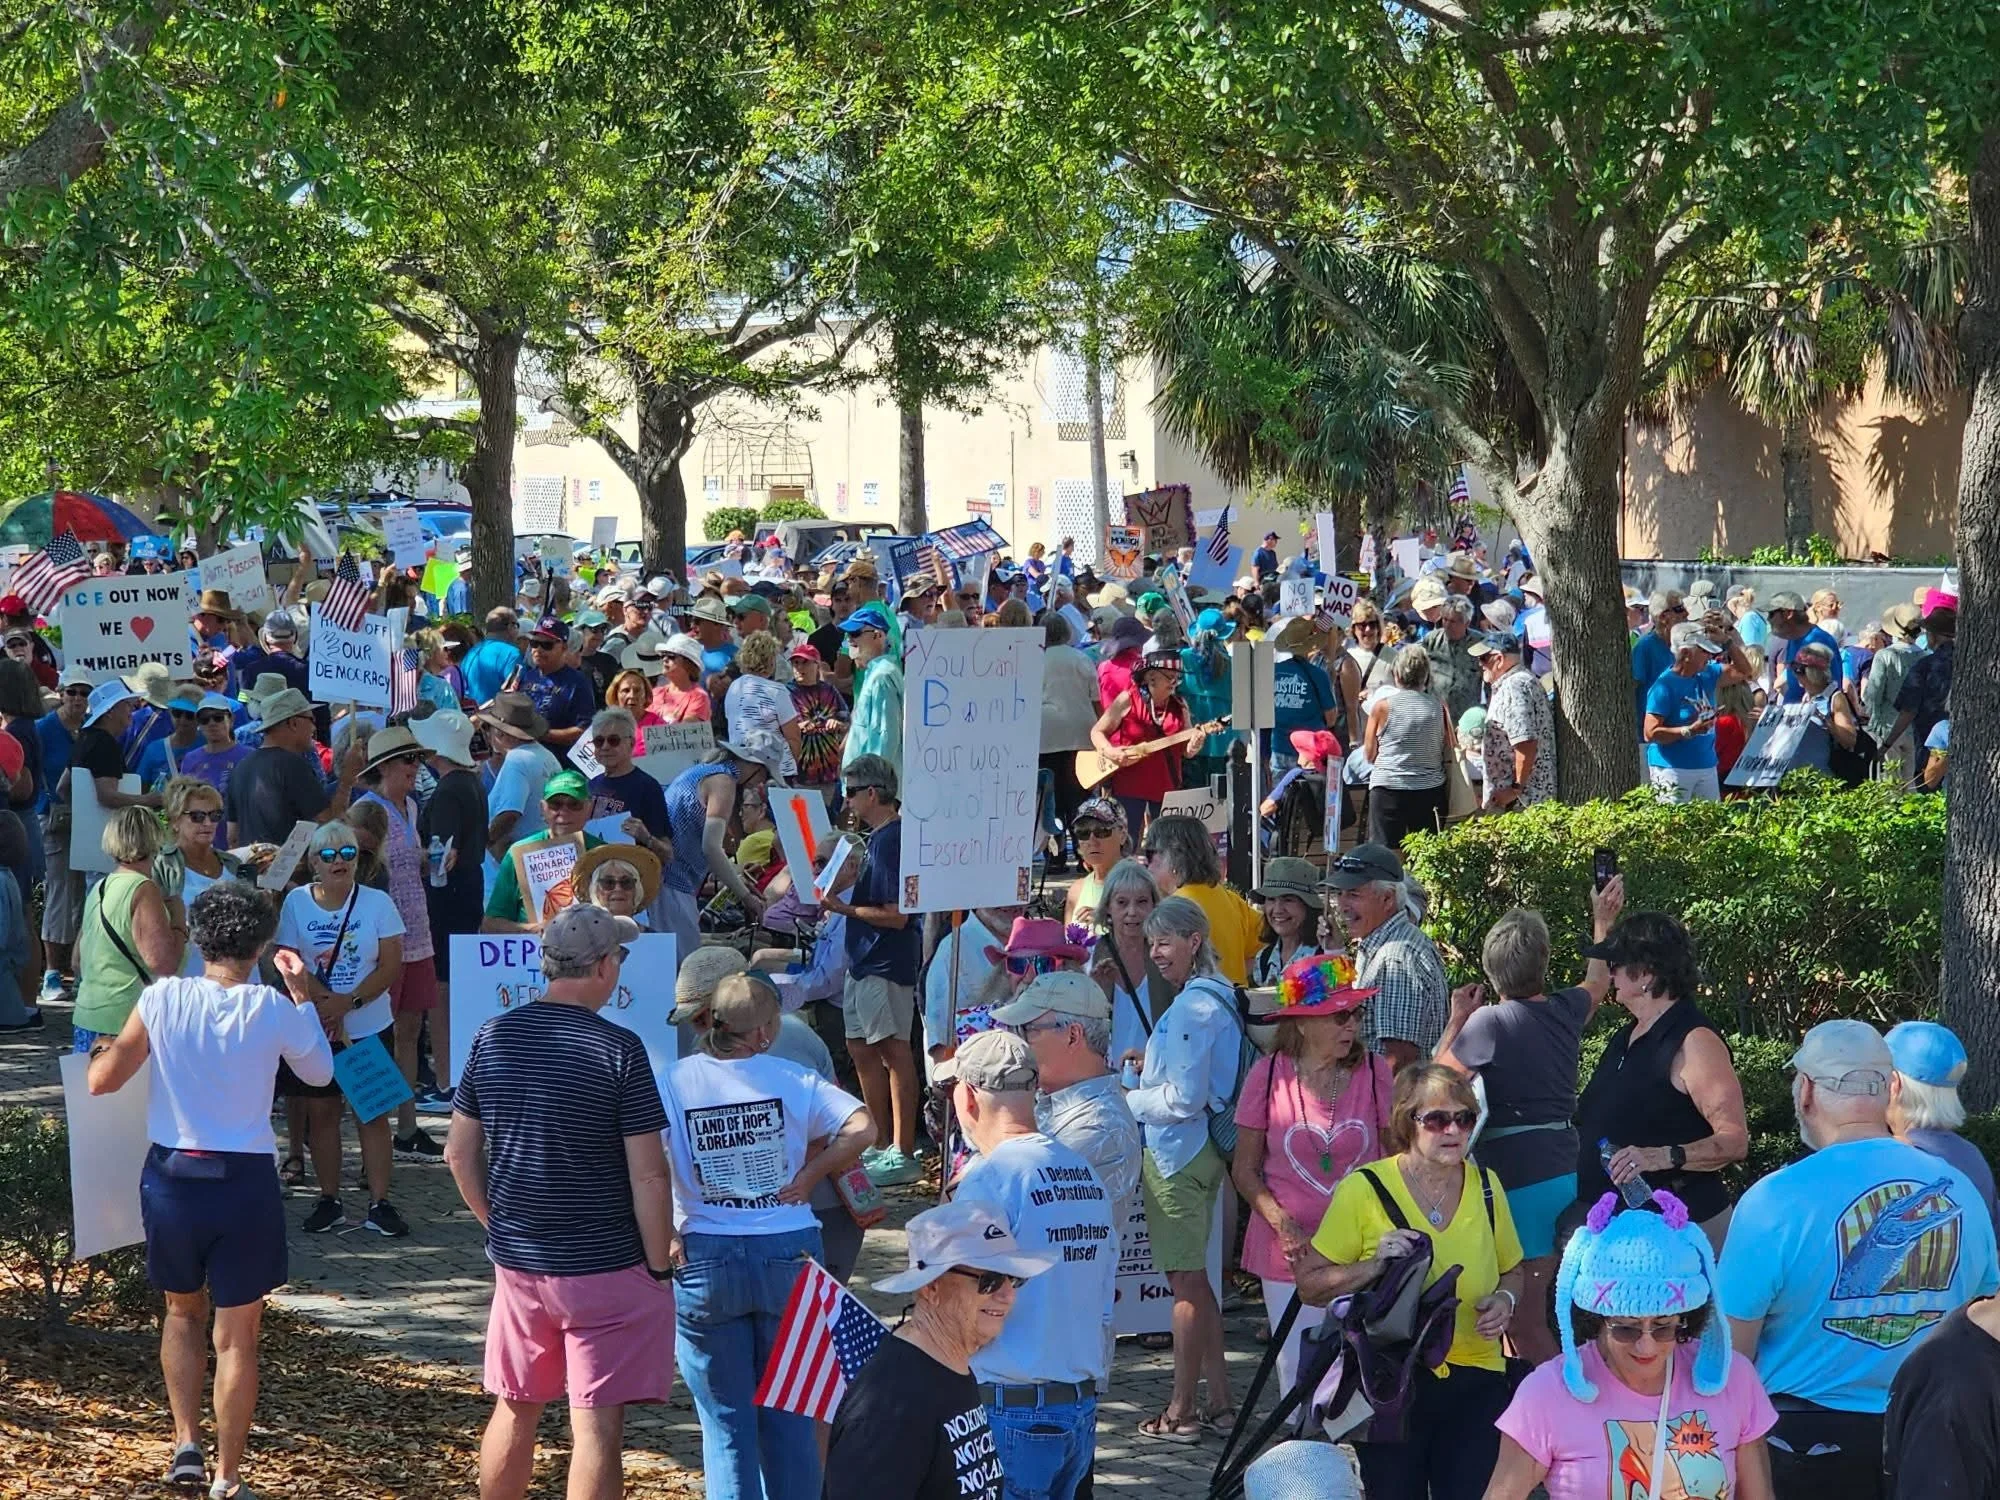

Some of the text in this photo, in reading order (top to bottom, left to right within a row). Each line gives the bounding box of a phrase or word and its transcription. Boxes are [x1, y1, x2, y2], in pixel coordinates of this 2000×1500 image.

[65, 592, 104, 607] ICE
[109, 589, 139, 604] OUT
[146, 587, 179, 602] NOW
[1288, 582, 1306, 596] NO
[1328, 581, 1353, 598] NO
[1286, 597, 1308, 612] WAR
[1323, 598, 1352, 617] WAR
[99, 621, 123, 636] WE
[364, 623, 387, 638] OFF
[342, 641, 372, 661] OUR
[914, 631, 965, 678] You
[76, 652, 183, 672] IMMIGRANTS
[315, 661, 391, 694] DEMOCRACY
[1274, 680, 1308, 695] USTICE
[923, 679, 1025, 727] Bomb
[577, 744, 594, 765] NO
[914, 728, 963, 773] Your
[527, 846, 574, 862] THE ONLY
[529, 855, 576, 873] MONARCH
[531, 867, 572, 884] I SUPPOR
[751, 1102, 777, 1112] STREET
[694, 1112, 773, 1136] LAND OF HOPE
[697, 1136, 706, 1152] &
[707, 1130, 756, 1151] DREAMS
[1037, 1166, 1093, 1183] I Defended
[1030, 1188, 1054, 1207] the
[1045, 1226, 1077, 1244] Trump
[1140, 1282, 1175, 1302] KIN
[943, 1414, 970, 1443] NO
[1681, 1433, 1704, 1446] NO!
[953, 1440, 977, 1470] NO
[957, 1467, 985, 1495] NO
